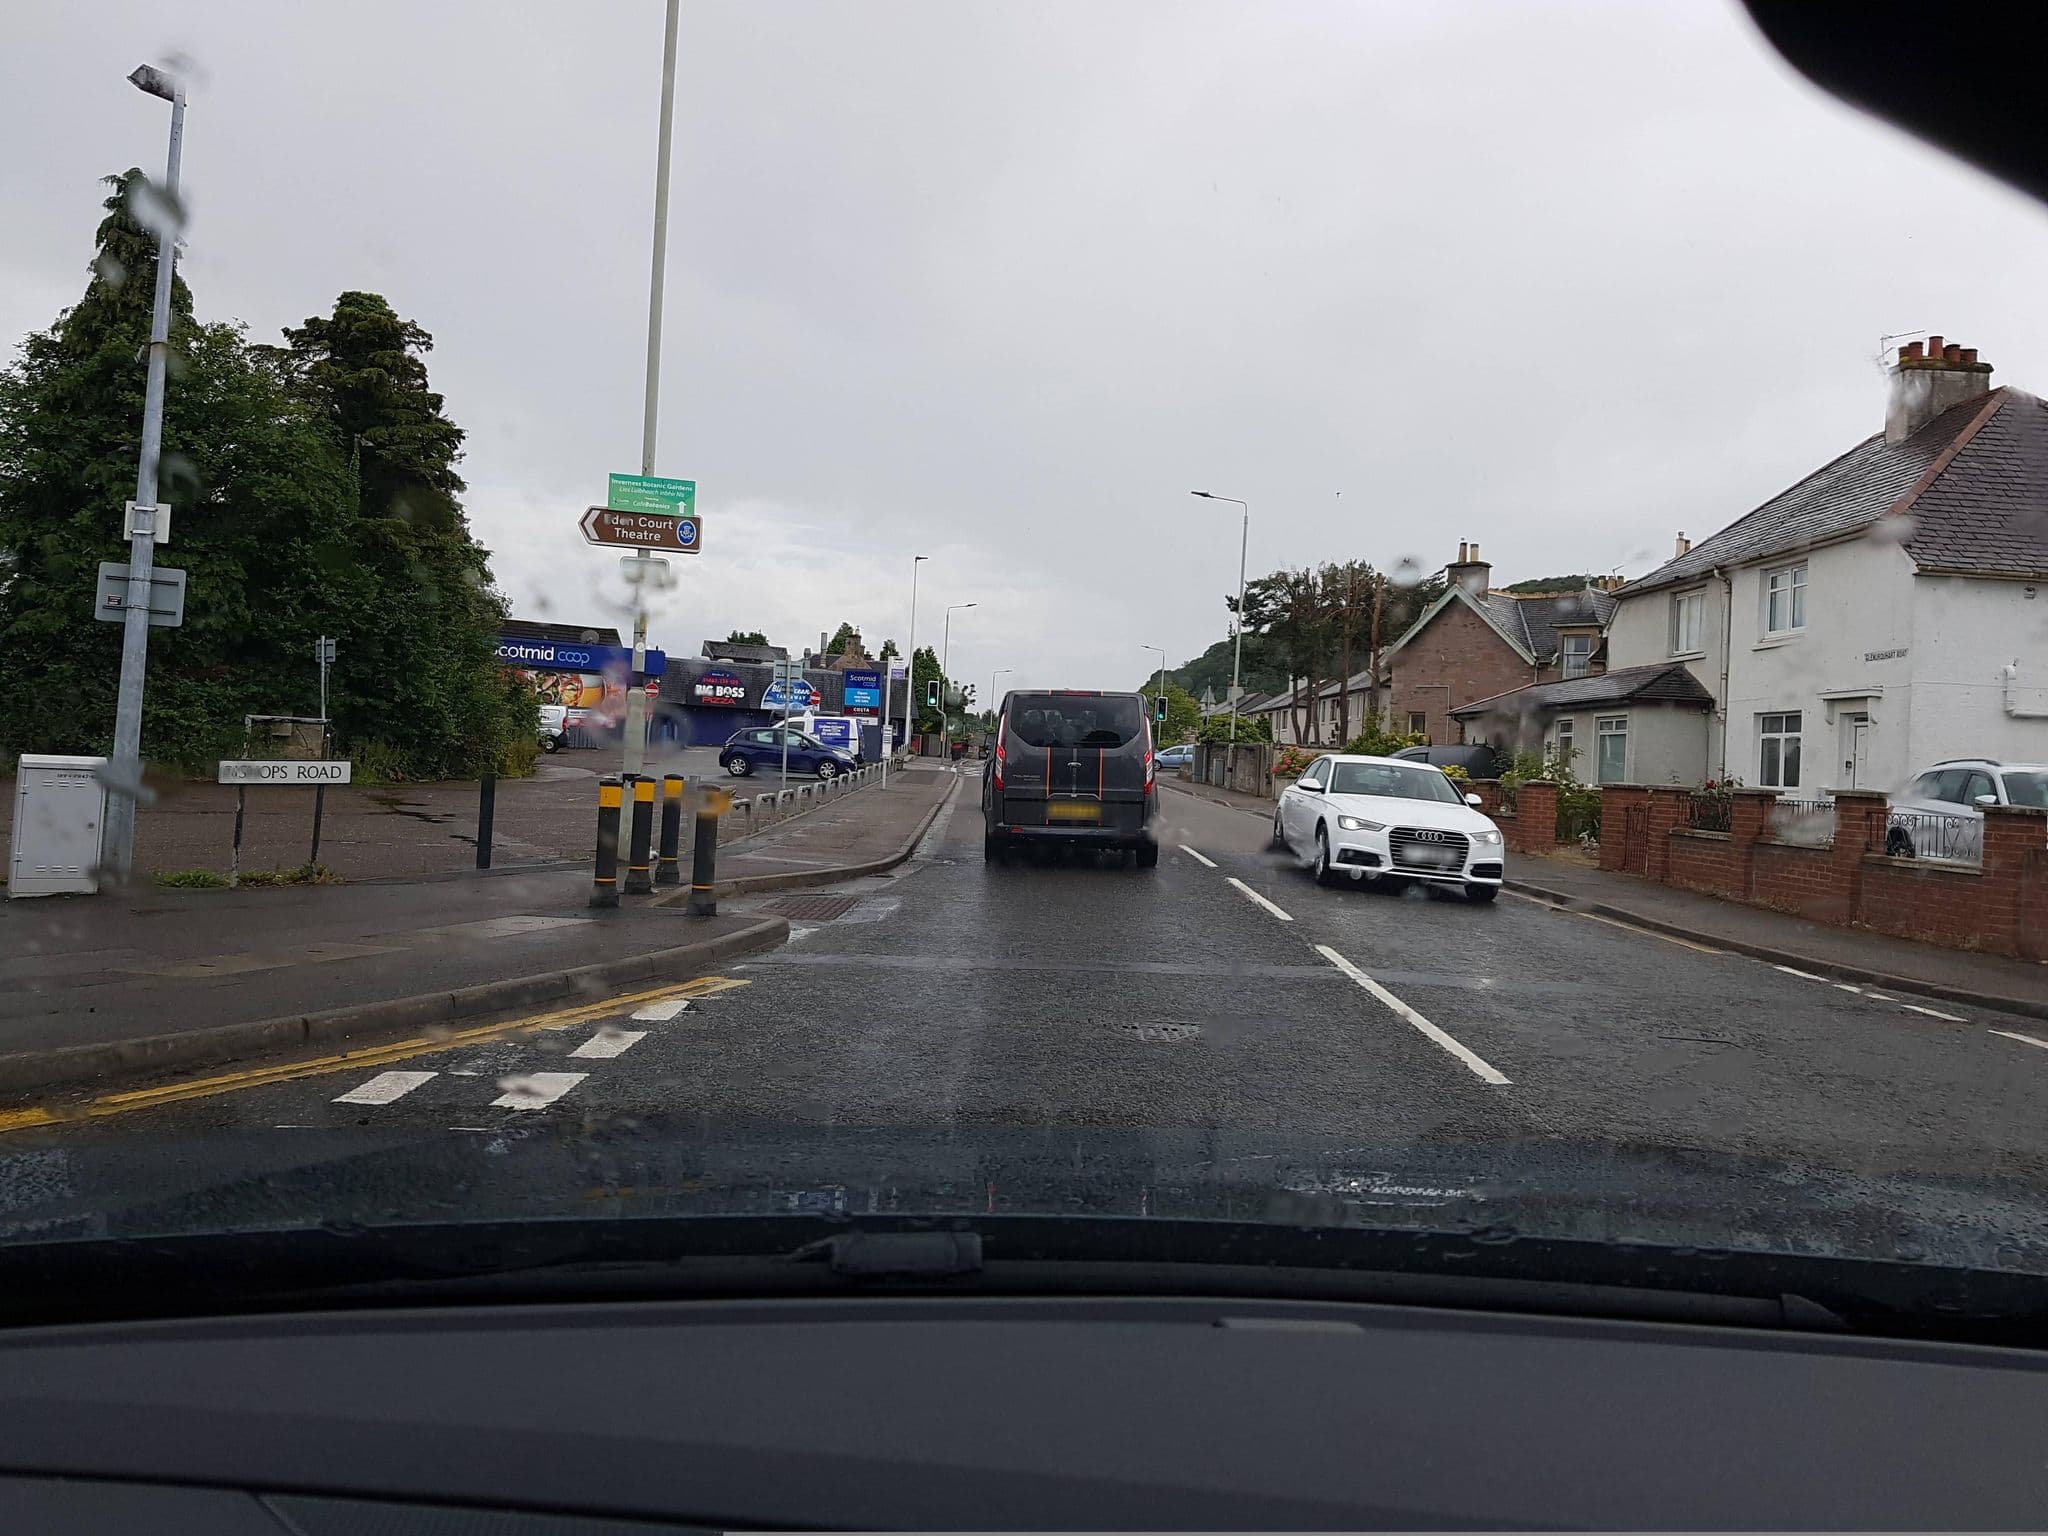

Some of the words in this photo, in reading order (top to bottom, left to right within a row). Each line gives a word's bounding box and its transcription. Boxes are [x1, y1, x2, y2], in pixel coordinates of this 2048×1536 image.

[639, 516, 673, 529] Court
[615, 527, 661, 541] Theatre
[695, 684, 714, 697] BIG
[716, 685, 745, 698] BOSS
[702, 696, 736, 705] PIZZA
[297, 766, 342, 779] ROAD
